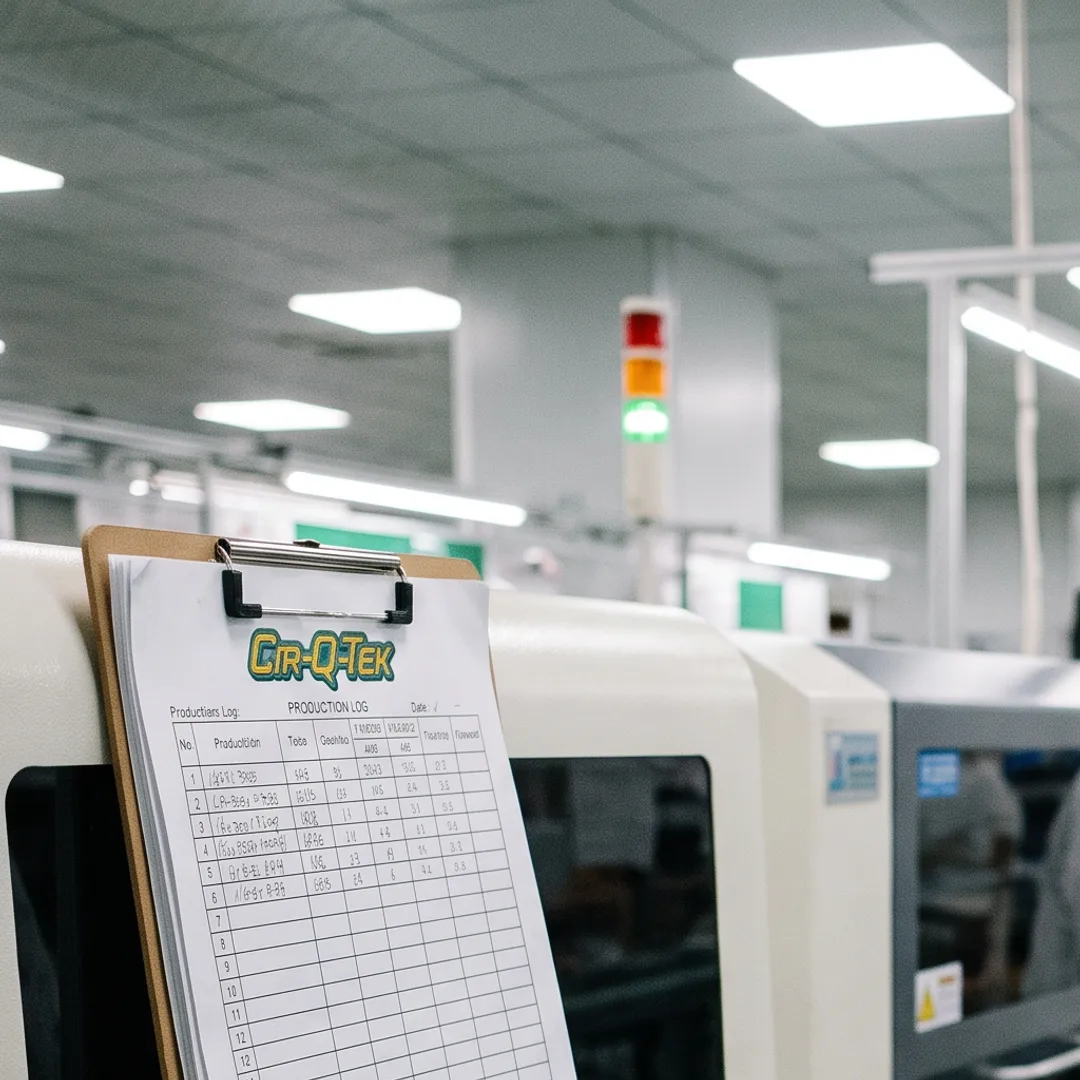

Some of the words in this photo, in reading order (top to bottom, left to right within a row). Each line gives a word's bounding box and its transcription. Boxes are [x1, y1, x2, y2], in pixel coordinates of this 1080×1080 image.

[221, 706, 240, 720] Log:
[288, 701, 349, 714] PRODUCTION
[351, 700, 369, 713] LOG
[190, 773, 196, 785] 1
[194, 797, 201, 810] 2
[199, 822, 205, 833] 3
[203, 844, 209, 856] 4
[207, 867, 213, 878] 5
[212, 892, 218, 904] 6
[216, 915, 221, 927] 7
[220, 938, 226, 950] 8
[225, 961, 230, 972] 9
[227, 985, 237, 998] 10
[232, 1009, 241, 1021] 11
[236, 1032, 246, 1044] 12
[241, 1054, 251, 1067] 12
